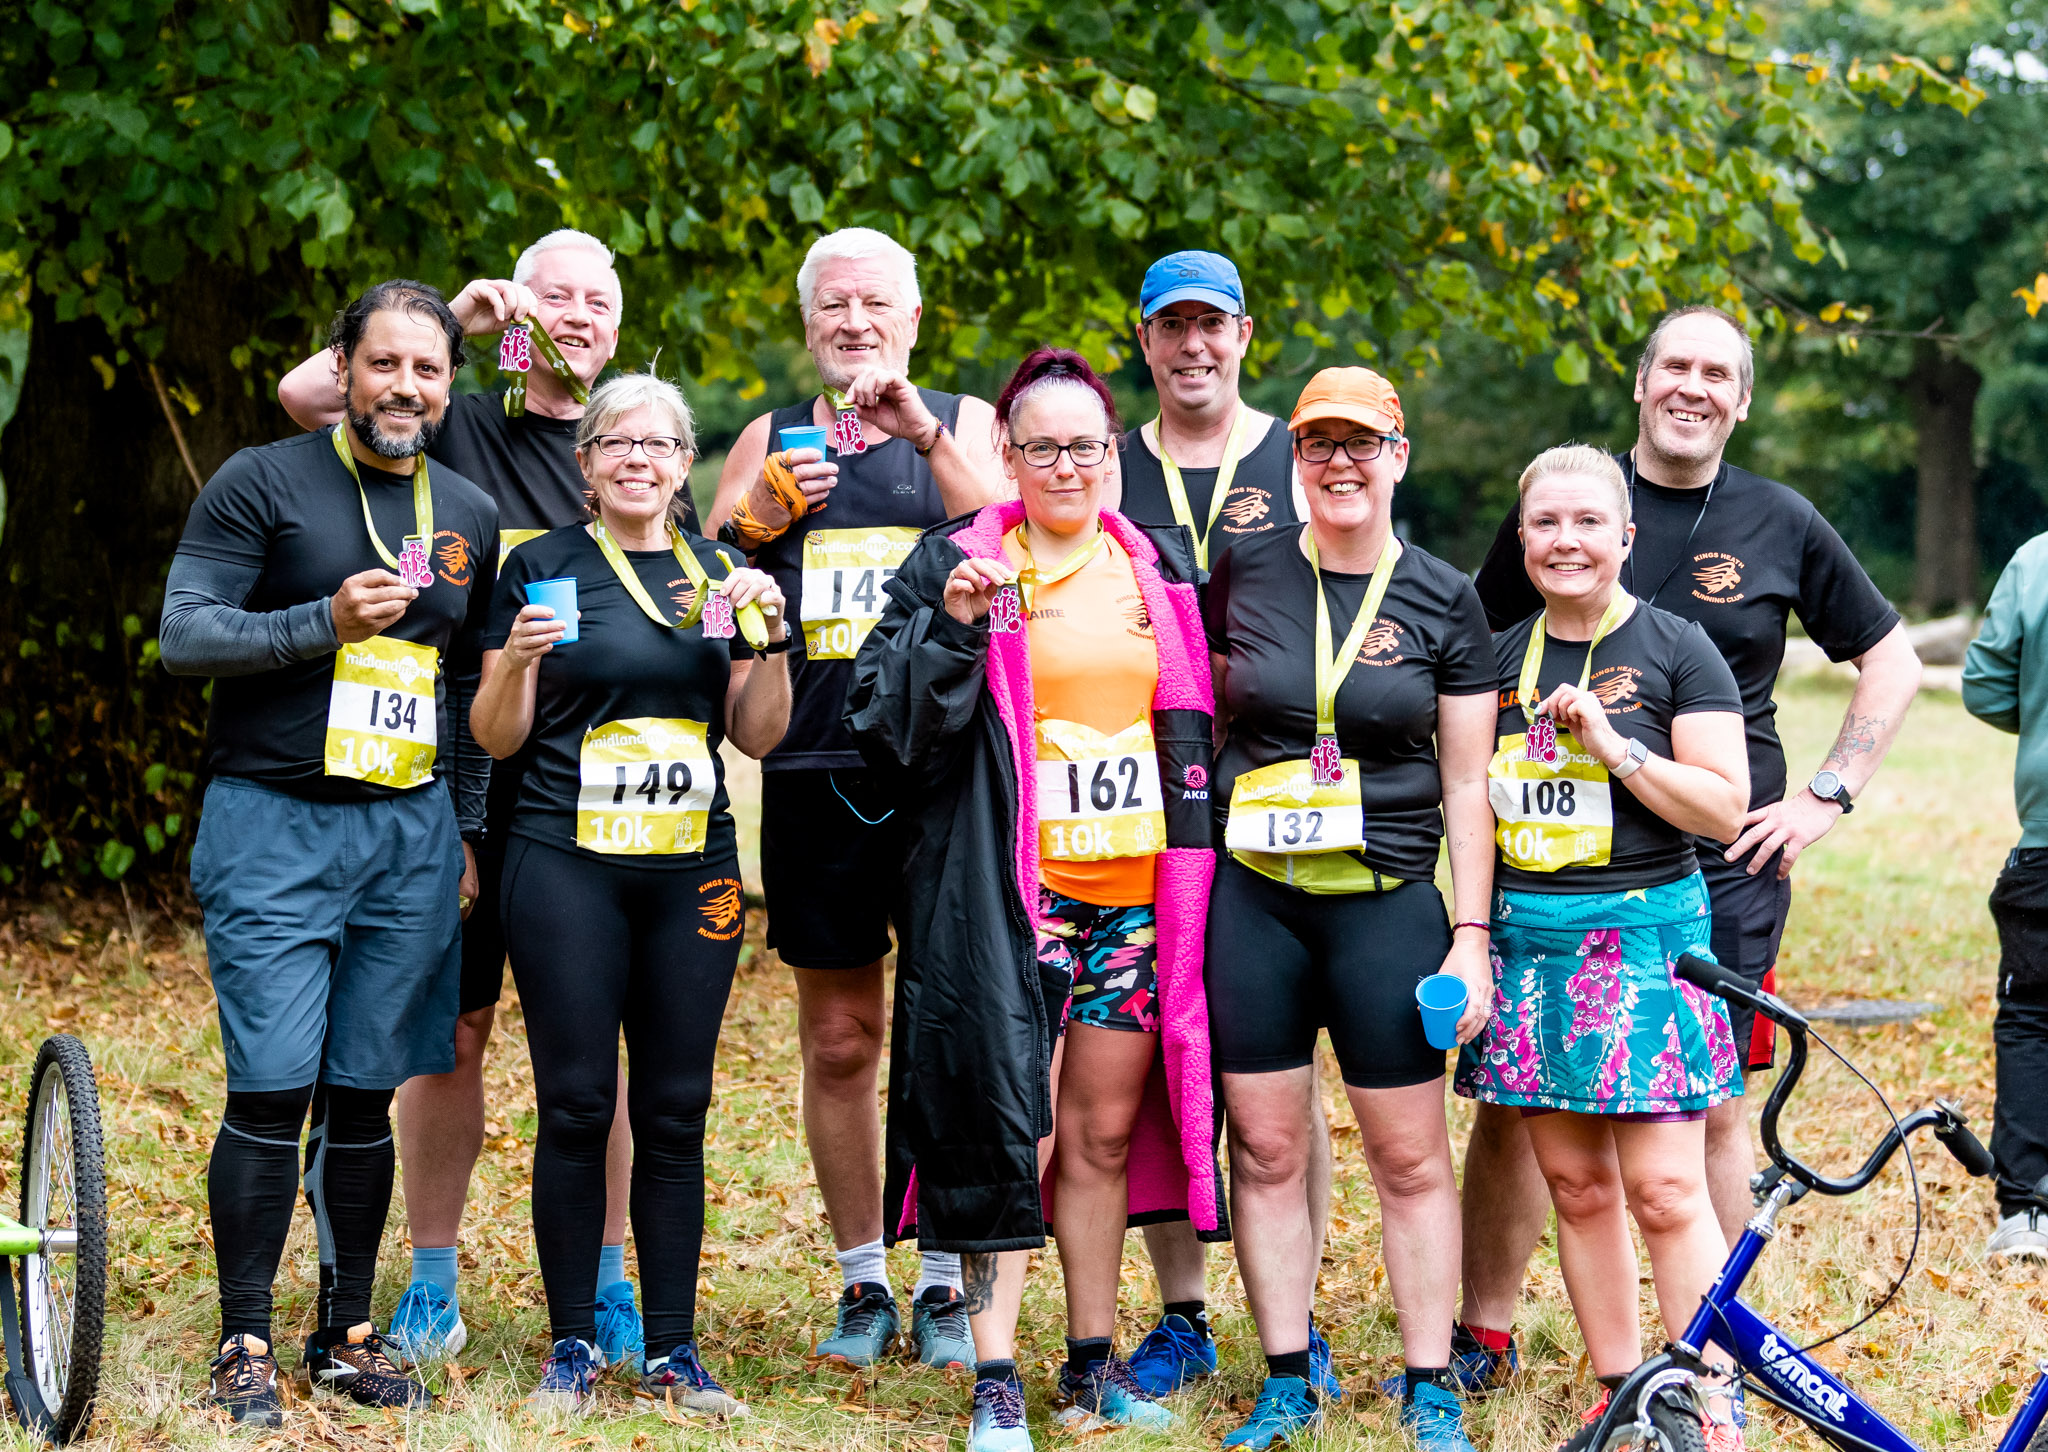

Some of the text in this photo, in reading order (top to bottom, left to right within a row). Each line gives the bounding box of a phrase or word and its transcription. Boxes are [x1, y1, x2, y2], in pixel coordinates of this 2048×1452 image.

[1246, 487, 1272, 499] HEATH
[1256, 522, 1275, 532] CLUB
[1694, 552, 1745, 569] KINGS HEATH
[1691, 590, 1744, 603] RUNNING CLUB
[1026, 608, 1065, 620] AIRE
[1379, 619, 1404, 635] HEATH
[815, 622, 868, 653] 10k
[1384, 655, 1404, 666] CLUB
[1590, 666, 1643, 681] KINGS HEATH
[370, 690, 417, 733] 134
[1622, 702, 1643, 713] CLUB
[340, 737, 398, 776] 10k
[613, 762, 692, 805] 149
[1068, 757, 1142, 813] 162
[1182, 790, 1208, 800] AKD
[1522, 781, 1576, 816] 108
[590, 816, 653, 848] 10k
[1269, 811, 1323, 847] 132
[1050, 823, 1114, 857] 10k
[1502, 828, 1553, 861] 10k
[698, 878, 742, 894] KINGS HEATH
[697, 927, 731, 940] RUNNING
[1759, 1333, 1848, 1421] tomcat
